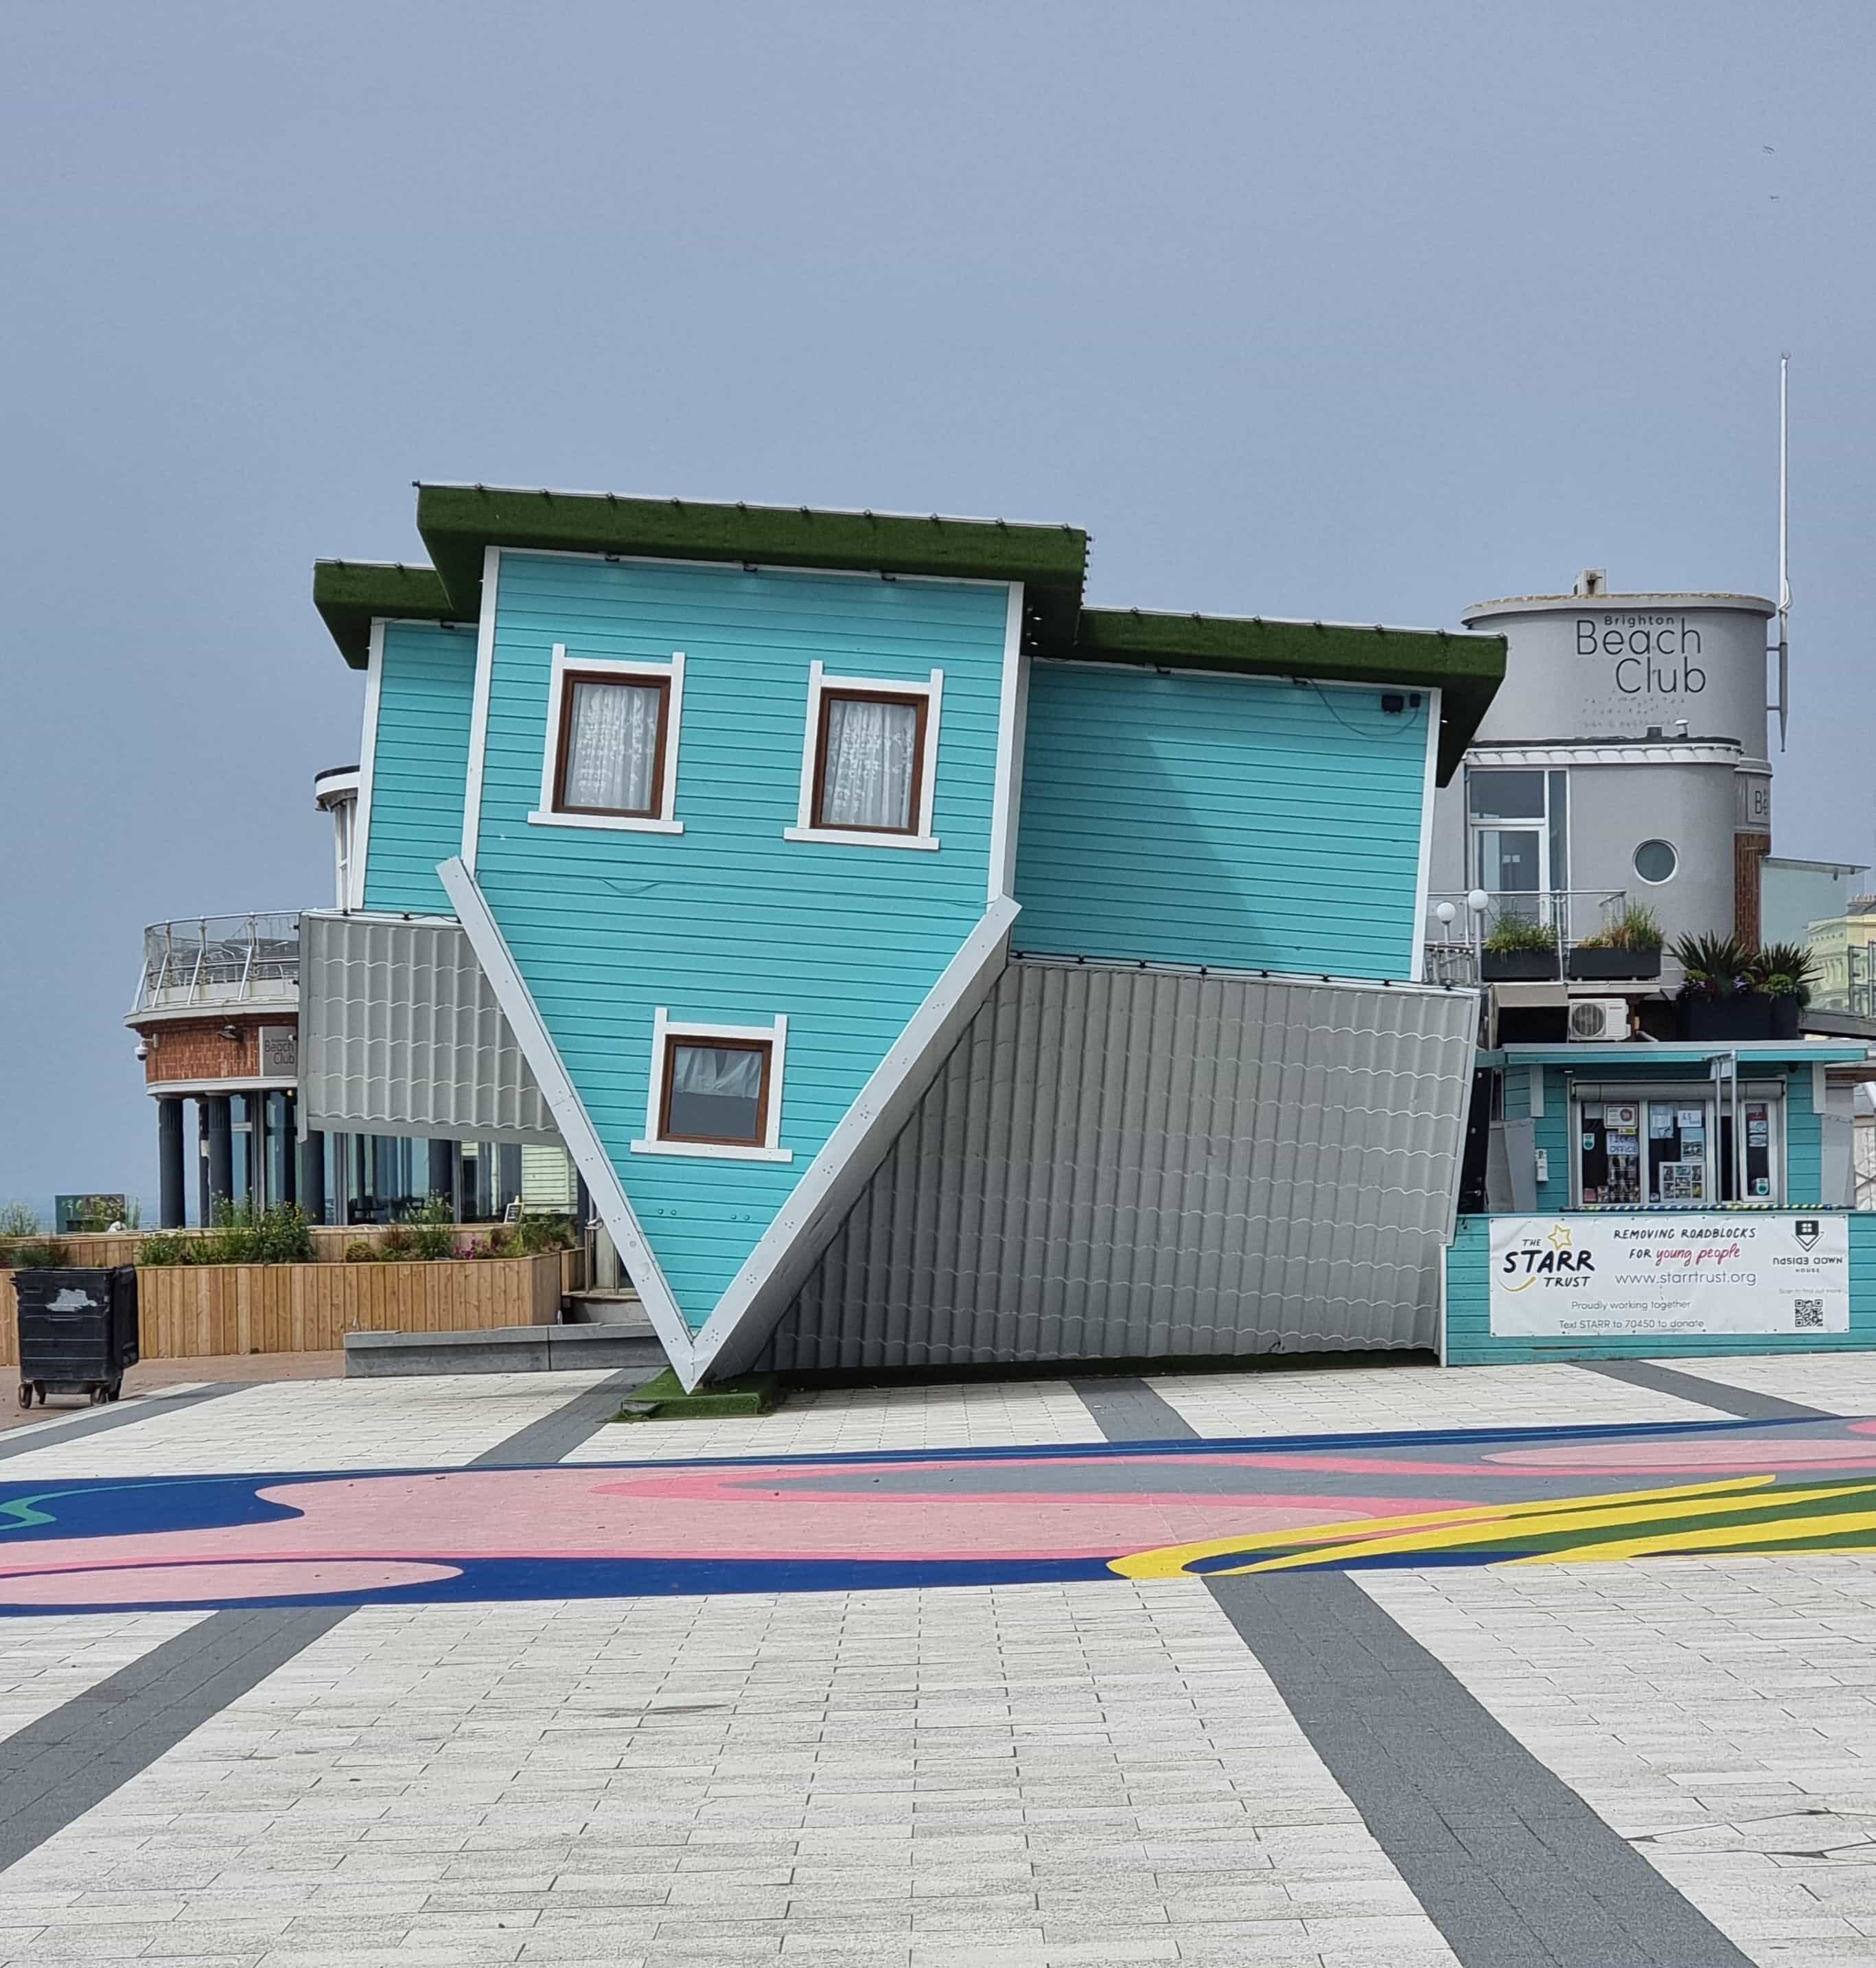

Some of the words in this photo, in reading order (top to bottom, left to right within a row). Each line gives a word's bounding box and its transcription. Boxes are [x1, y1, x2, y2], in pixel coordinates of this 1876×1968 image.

[1604, 615, 1674, 627] Brighton
[1577, 617, 1701, 655] Beach
[1616, 656, 1706, 693] Club
[264, 1039, 294, 1052] Beach
[273, 1052, 295, 1065] Club
[1614, 1229, 1675, 1240] REMOVING
[1681, 1227, 1757, 1239] ROADBLOCKS
[1522, 1238, 1542, 1247] THE
[1503, 1249, 1596, 1273] STARR
[1629, 1248, 1652, 1259] FOR
[1655, 1248, 1693, 1267] young
[1695, 1242, 1741, 1265] people
[1543, 1276, 1591, 1288] TRUST
[1614, 1271, 1757, 1286] www.starrtrust.org
[1571, 1301, 1607, 1311] Proudly
[1610, 1301, 1647, 1311] working
[1651, 1301, 1691, 1310] together
[1559, 1319, 1577, 1329] Text
[1579, 1319, 1610, 1329] STARR
[1613, 1320, 1623, 1329] to
[1625, 1319, 1656, 1328] 70450
[1658, 1319, 1667, 1328] to
[1669, 1319, 1704, 1328] donate
